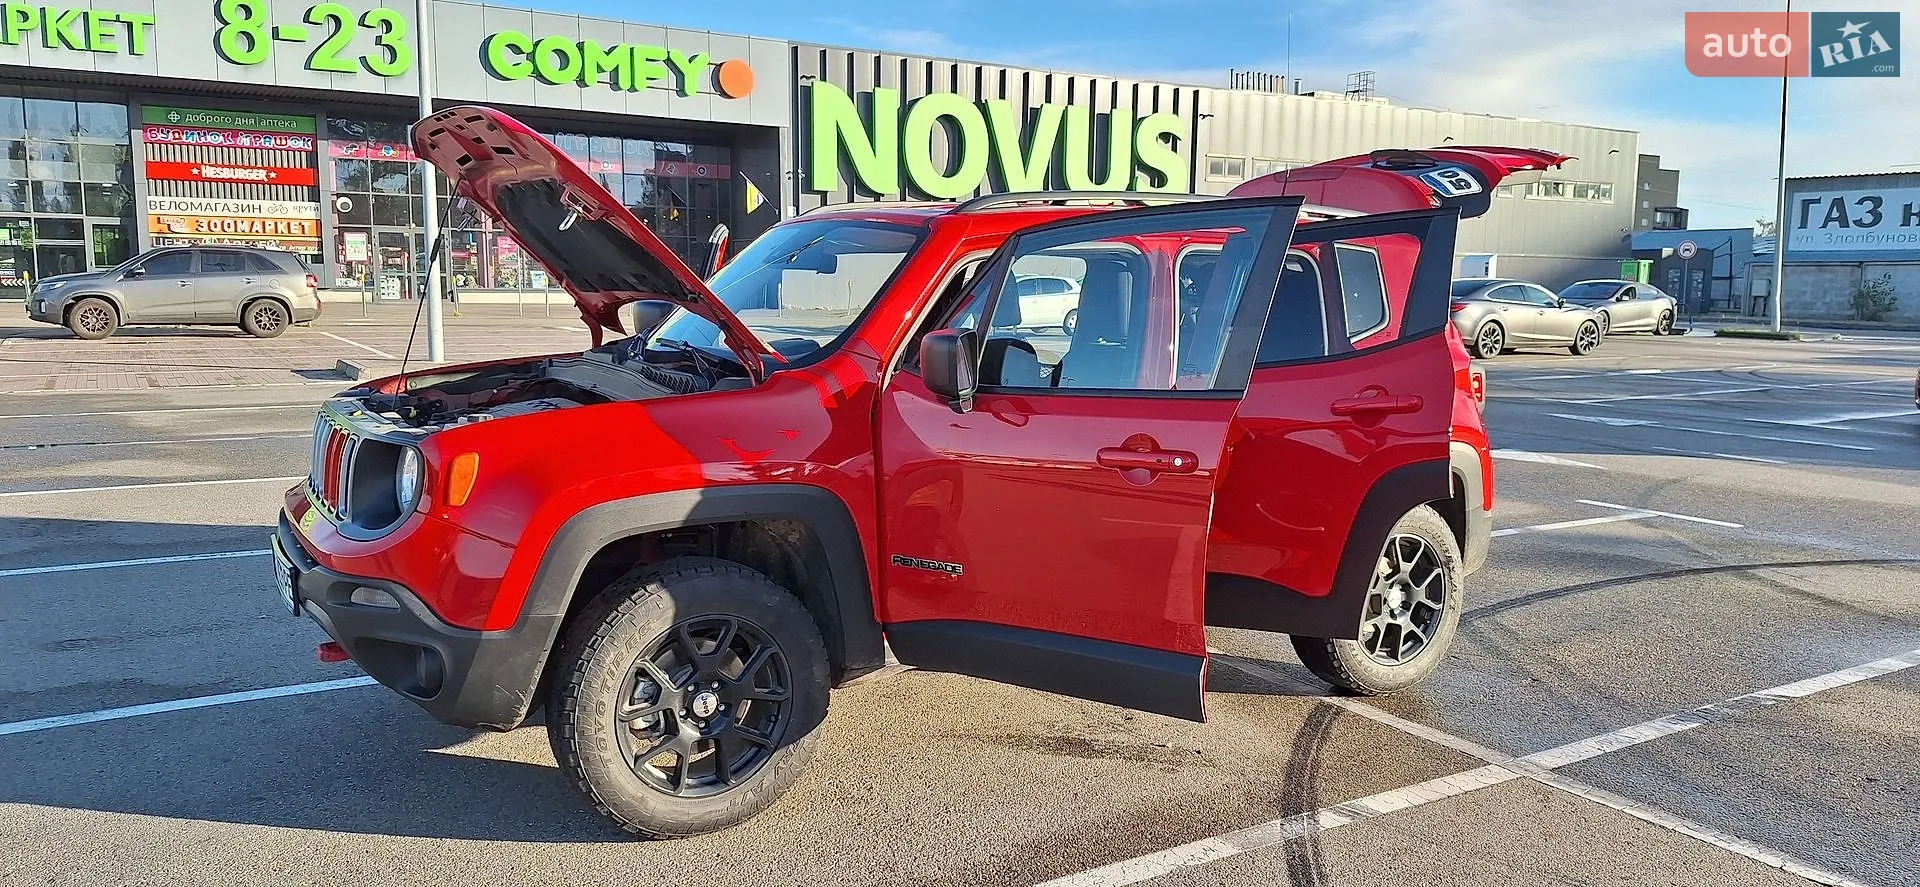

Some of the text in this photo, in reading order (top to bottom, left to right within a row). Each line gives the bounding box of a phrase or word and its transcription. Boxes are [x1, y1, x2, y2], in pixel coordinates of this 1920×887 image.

[0, 3, 154, 56] РКЕТ
[213, 0, 411, 77] 8-23
[479, 30, 710, 97] COMFY
[185, 113, 232, 124] доброго
[260, 118, 297, 128] аптека
[147, 127, 235, 145] БУДИНОК
[810, 80, 1189, 205] NOVUS
[149, 200, 262, 214] ВЕЛОМАГАЗИН
[1798, 195, 1884, 230] ГАЗ
[196, 218, 312, 235] ЗООМАРКЕТ
[891, 554, 964, 576] RENEGADE
